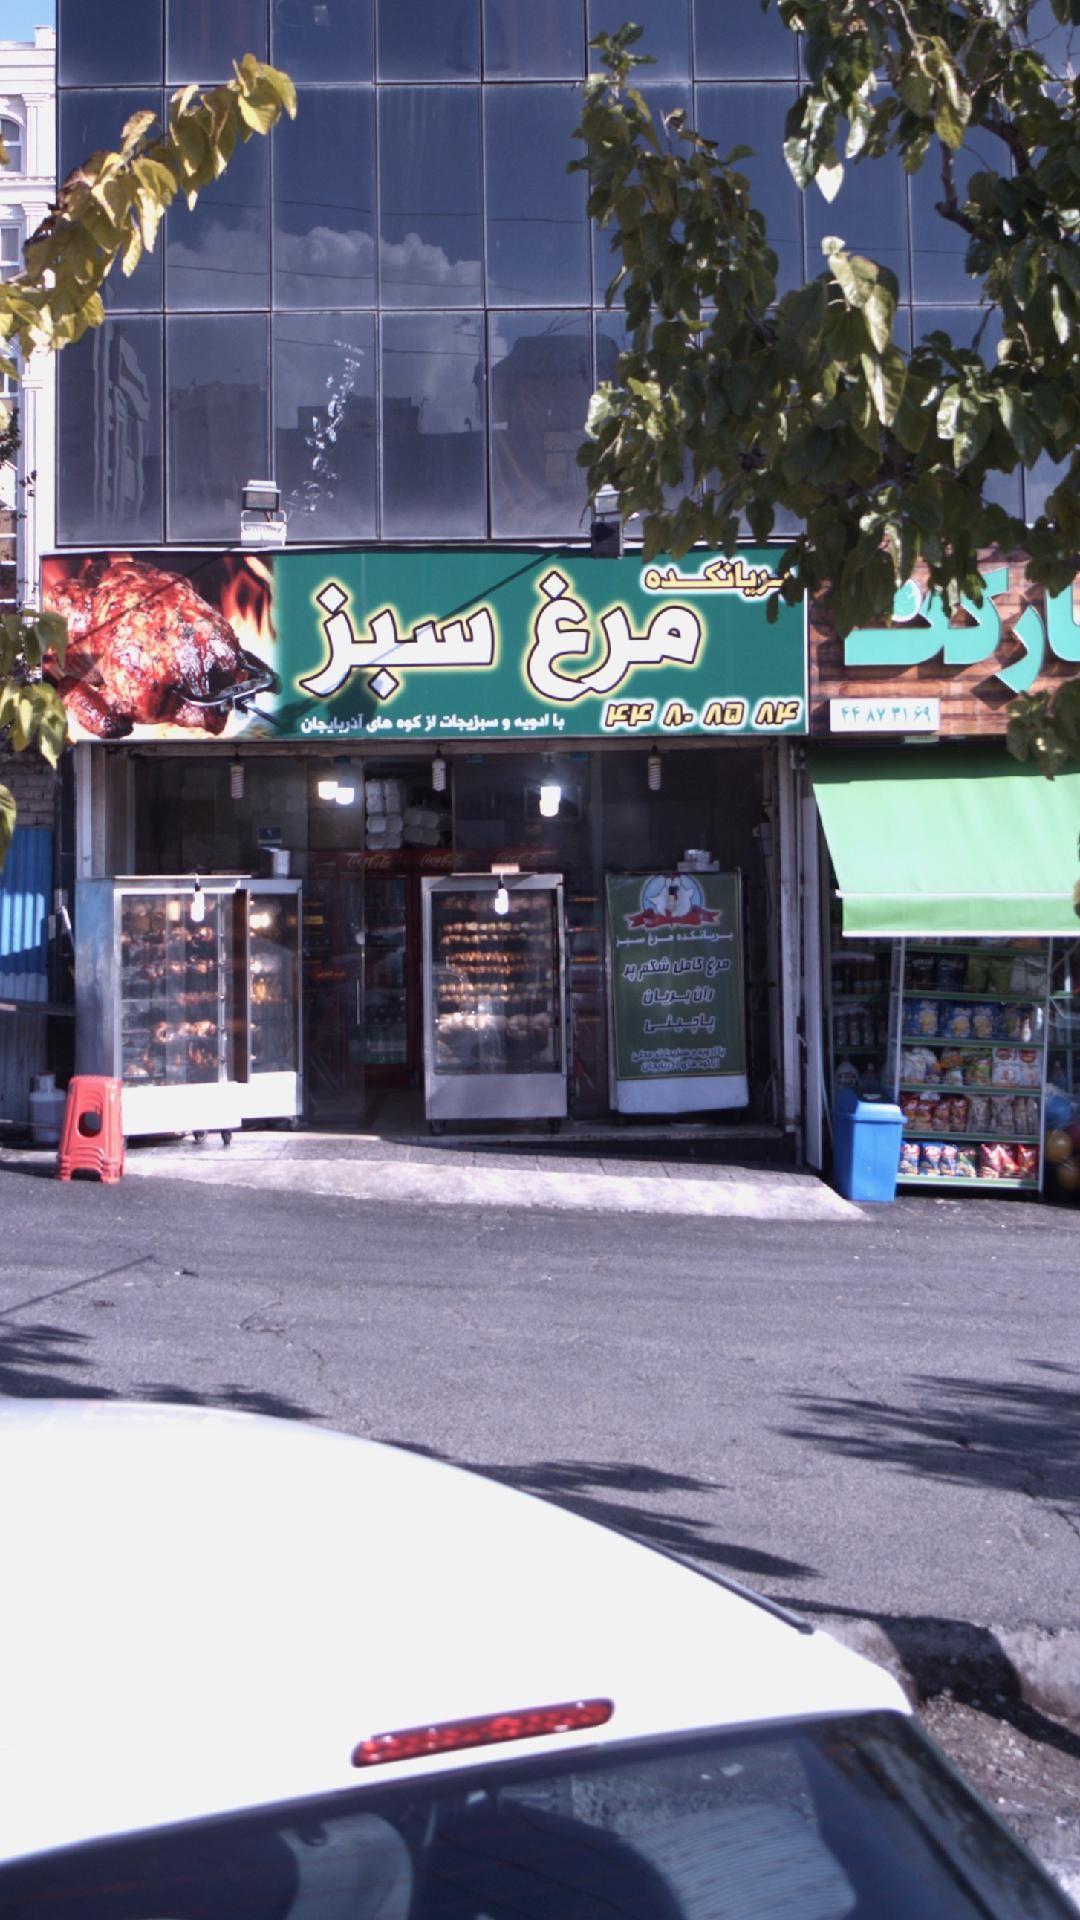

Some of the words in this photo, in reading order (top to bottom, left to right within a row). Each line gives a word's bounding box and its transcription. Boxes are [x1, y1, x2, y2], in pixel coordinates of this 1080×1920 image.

[298, 582, 496, 700] سبز
[526, 570, 702, 700] مرغ
[300, 712, 363, 734] آذربایجان
[395, 713, 423, 733] کوه
[424, 713, 436, 733] از
[438, 713, 499, 732] سبزیجات
[513, 712, 550, 731] ادویه
[552, 712, 566, 732] با
[604, 702, 653, 727] ۴۴
[662, 702, 693, 726] ۸۰
[703, 700, 744, 726] ۸۵
[754, 700, 799, 725] ۸۴
[365, 714, 393, 734] های
[501, 717, 511, 731] و
[622, 963, 638, 982] پر
[636, 955, 671, 982] شکم
[672, 957, 704, 976] کامل
[705, 955, 731, 978] مرغ
[641, 987, 692, 1006] بریان
[692, 985, 716, 1003] ران
